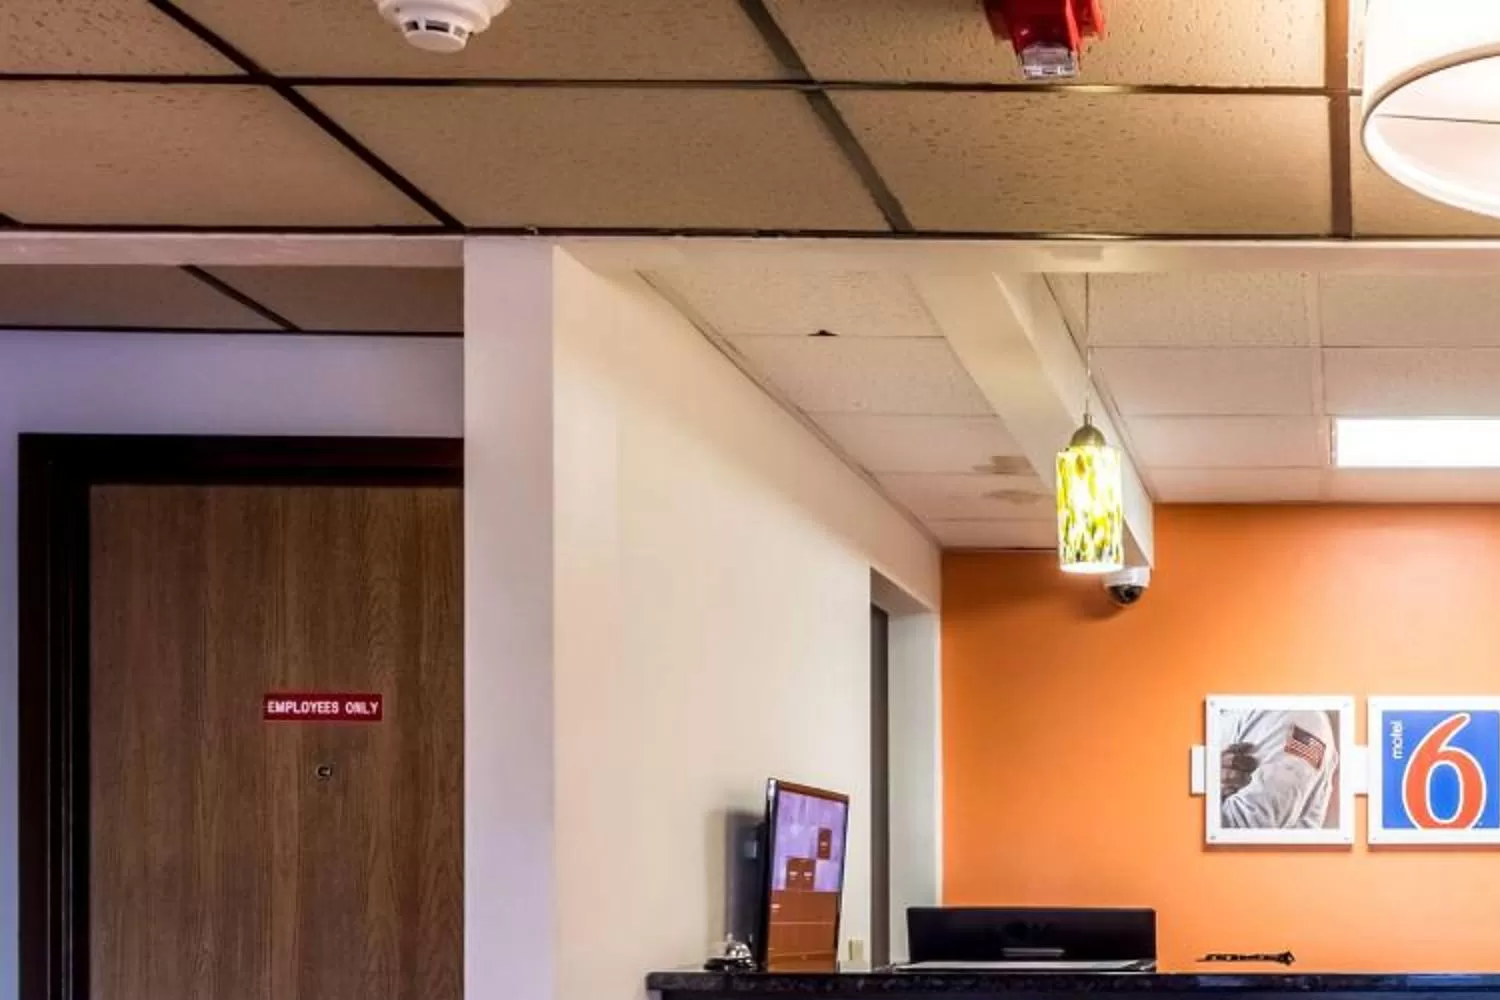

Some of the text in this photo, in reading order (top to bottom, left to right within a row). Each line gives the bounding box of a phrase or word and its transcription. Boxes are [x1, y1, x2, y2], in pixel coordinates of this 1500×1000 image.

[267, 701, 379, 714] EMPLOYEES ONLY
[1402, 712, 1487, 829] 6
